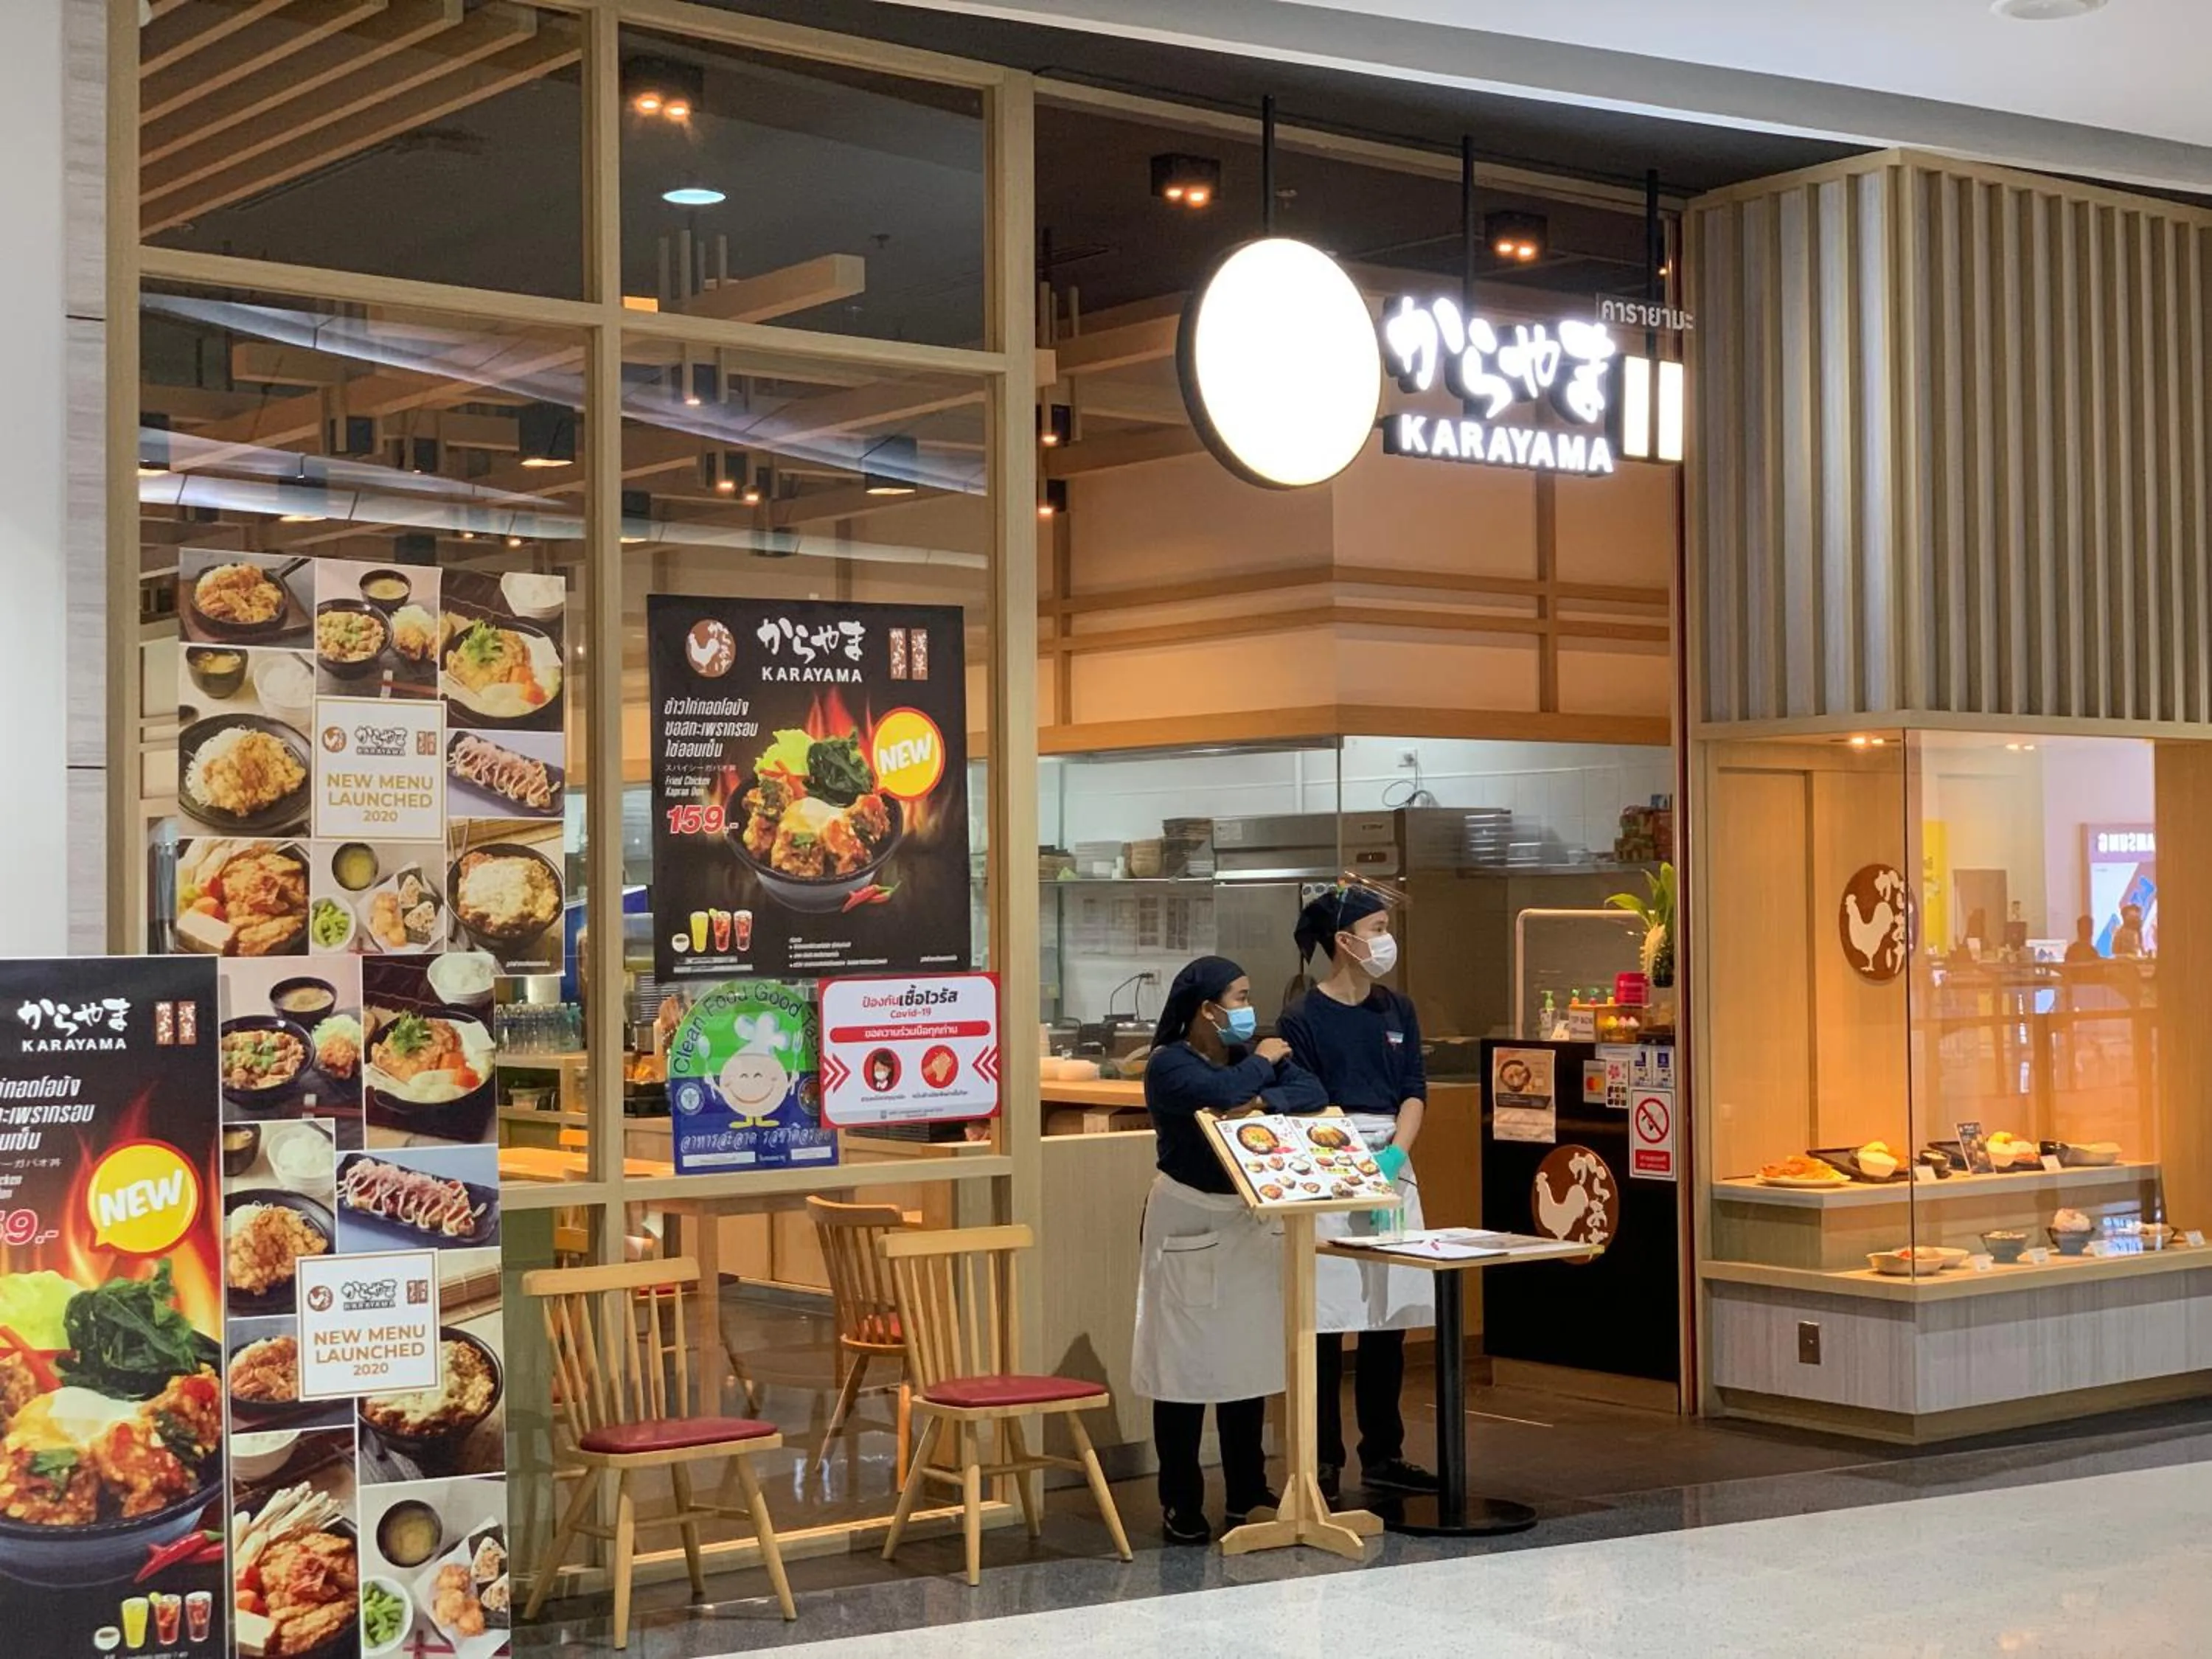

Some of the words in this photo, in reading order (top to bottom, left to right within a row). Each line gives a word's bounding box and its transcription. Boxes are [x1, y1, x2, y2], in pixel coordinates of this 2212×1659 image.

[1601, 299, 1694, 330] คารายามะ
[1399, 414, 1614, 474] KARAYAMA
[762, 667, 863, 684] KARAYAMA
[877, 733, 934, 775] NEW
[327, 773, 373, 788] NEW
[379, 774, 434, 790] MENU
[328, 791, 433, 808] LAUNCHED
[362, 810, 398, 822] 2020
[890, 1007, 931, 1019] Covid-19
[673, 1016, 707, 1074] Clean
[703, 987, 748, 1018] Food
[754, 982, 803, 1018] Good
[21, 1037, 128, 1053] KARAYAMA
[0, 1104, 96, 1124] ะเพรากรอบ
[97, 1168, 184, 1228] NEW
[313, 1329, 362, 1346] NEW
[368, 1324, 426, 1343] MENU
[316, 1342, 425, 1364] LAUNCHED
[353, 1363, 389, 1377] 2020
